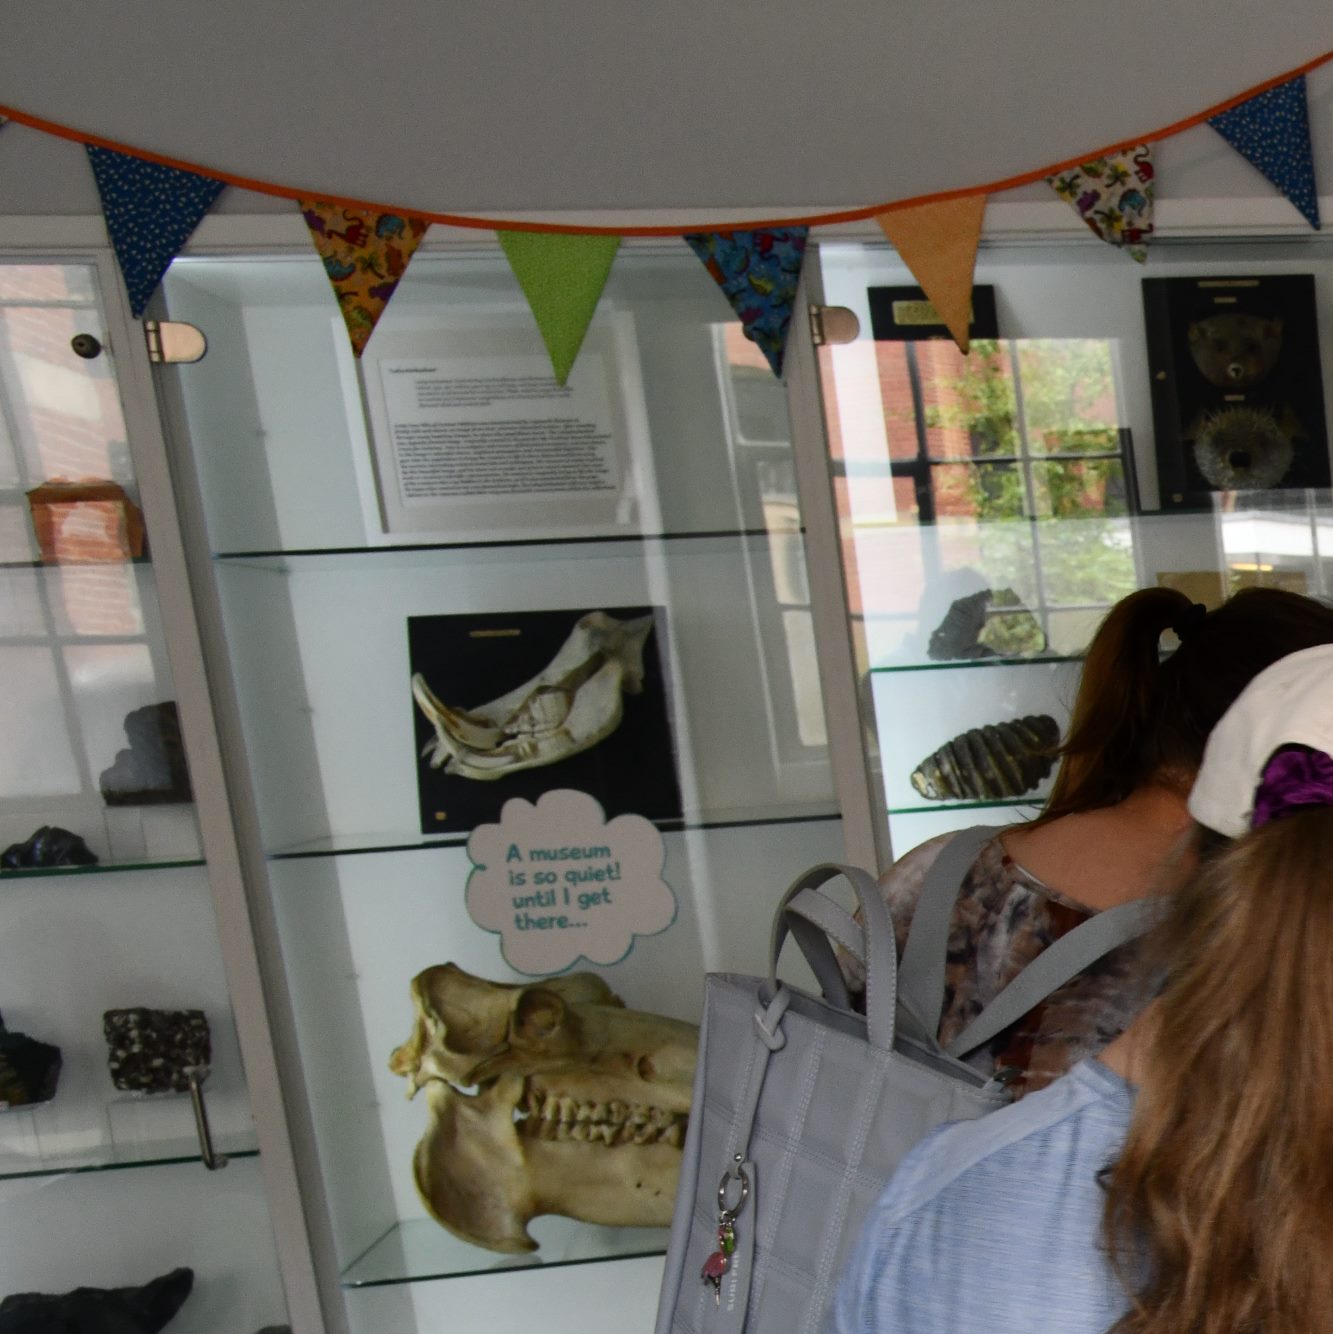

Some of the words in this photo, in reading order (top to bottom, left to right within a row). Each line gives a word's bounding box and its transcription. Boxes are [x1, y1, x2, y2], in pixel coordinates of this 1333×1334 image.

[506, 843, 522, 863] A
[529, 844, 612, 862] museum
[508, 870, 526, 886] is
[534, 871, 558, 886] so
[564, 861, 622, 887] quiet!
[512, 889, 556, 909] until
[563, 890, 570, 905] I
[577, 887, 613, 910] get
[513, 912, 589, 931] there...
